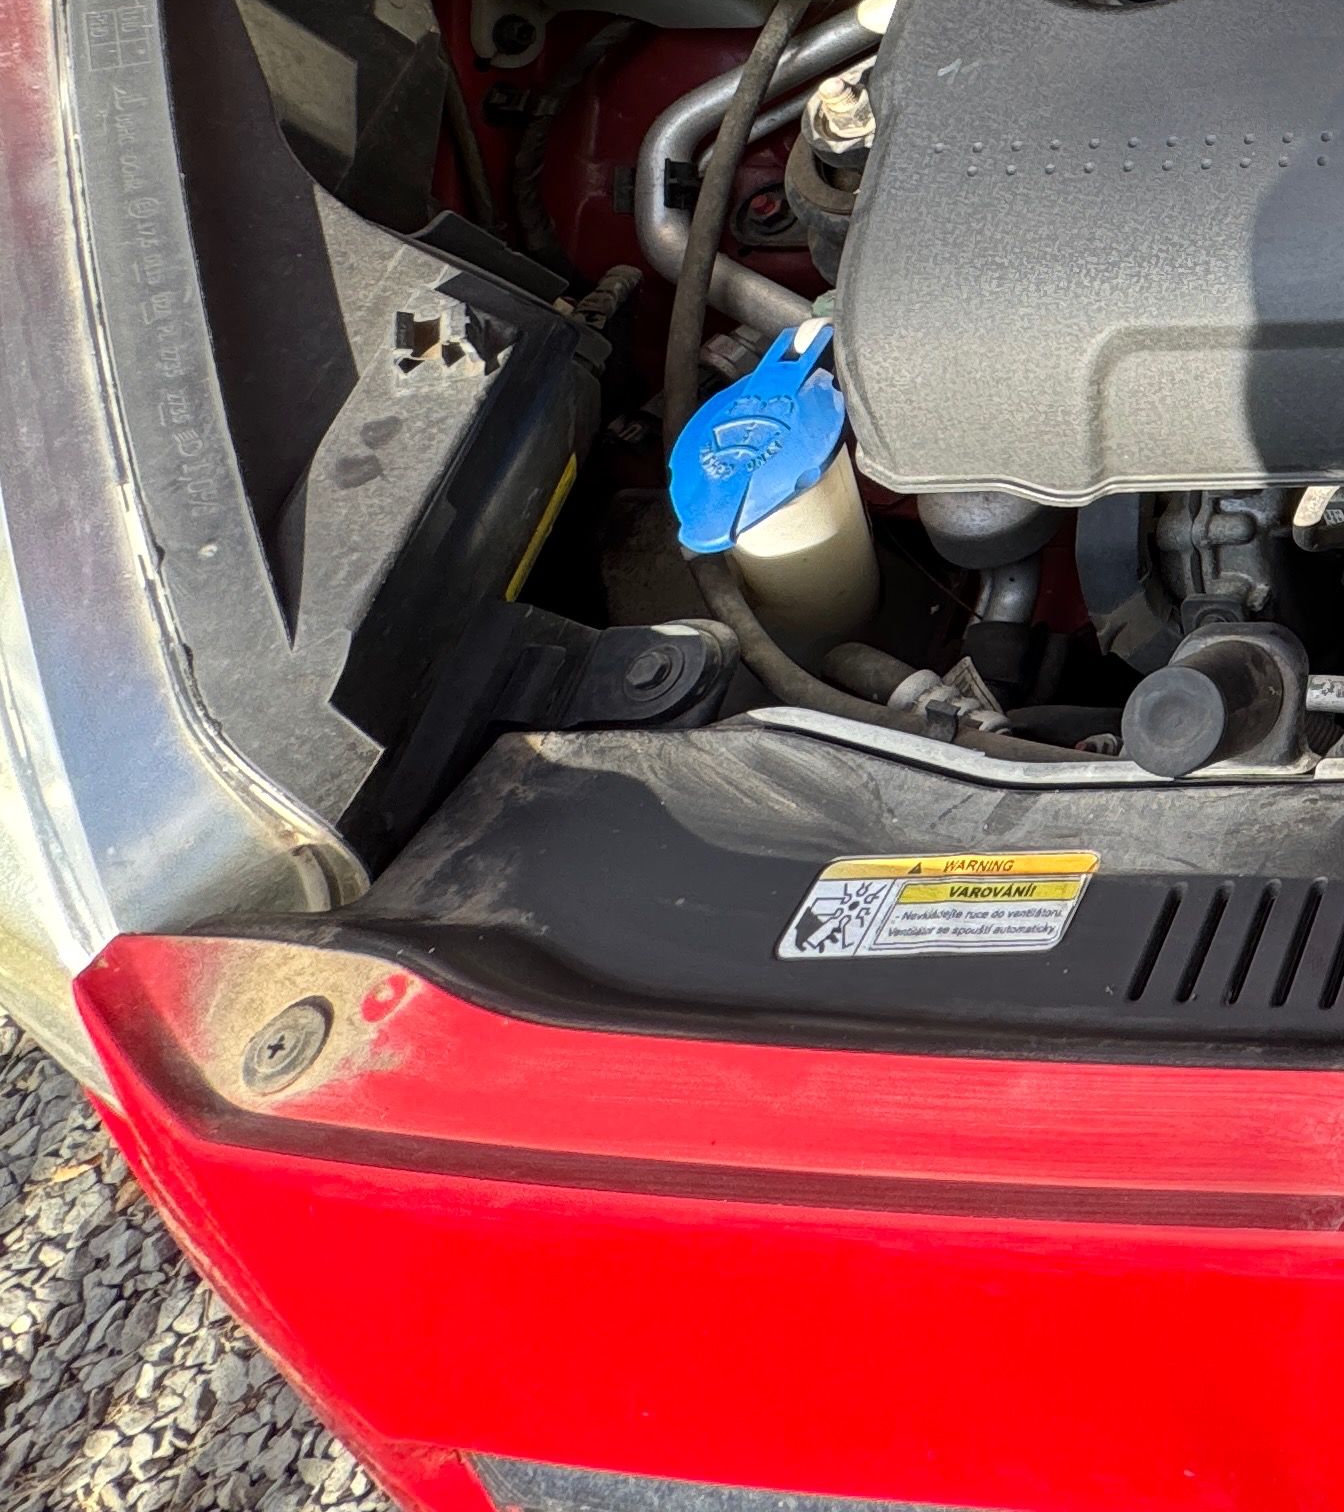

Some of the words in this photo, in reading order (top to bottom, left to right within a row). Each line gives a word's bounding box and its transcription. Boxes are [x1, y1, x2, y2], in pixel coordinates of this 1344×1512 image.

[943, 859, 1015, 873] WARNING
[965, 910, 989, 919] ruce
[991, 909, 1005, 919] do
[938, 927, 950, 935] se
